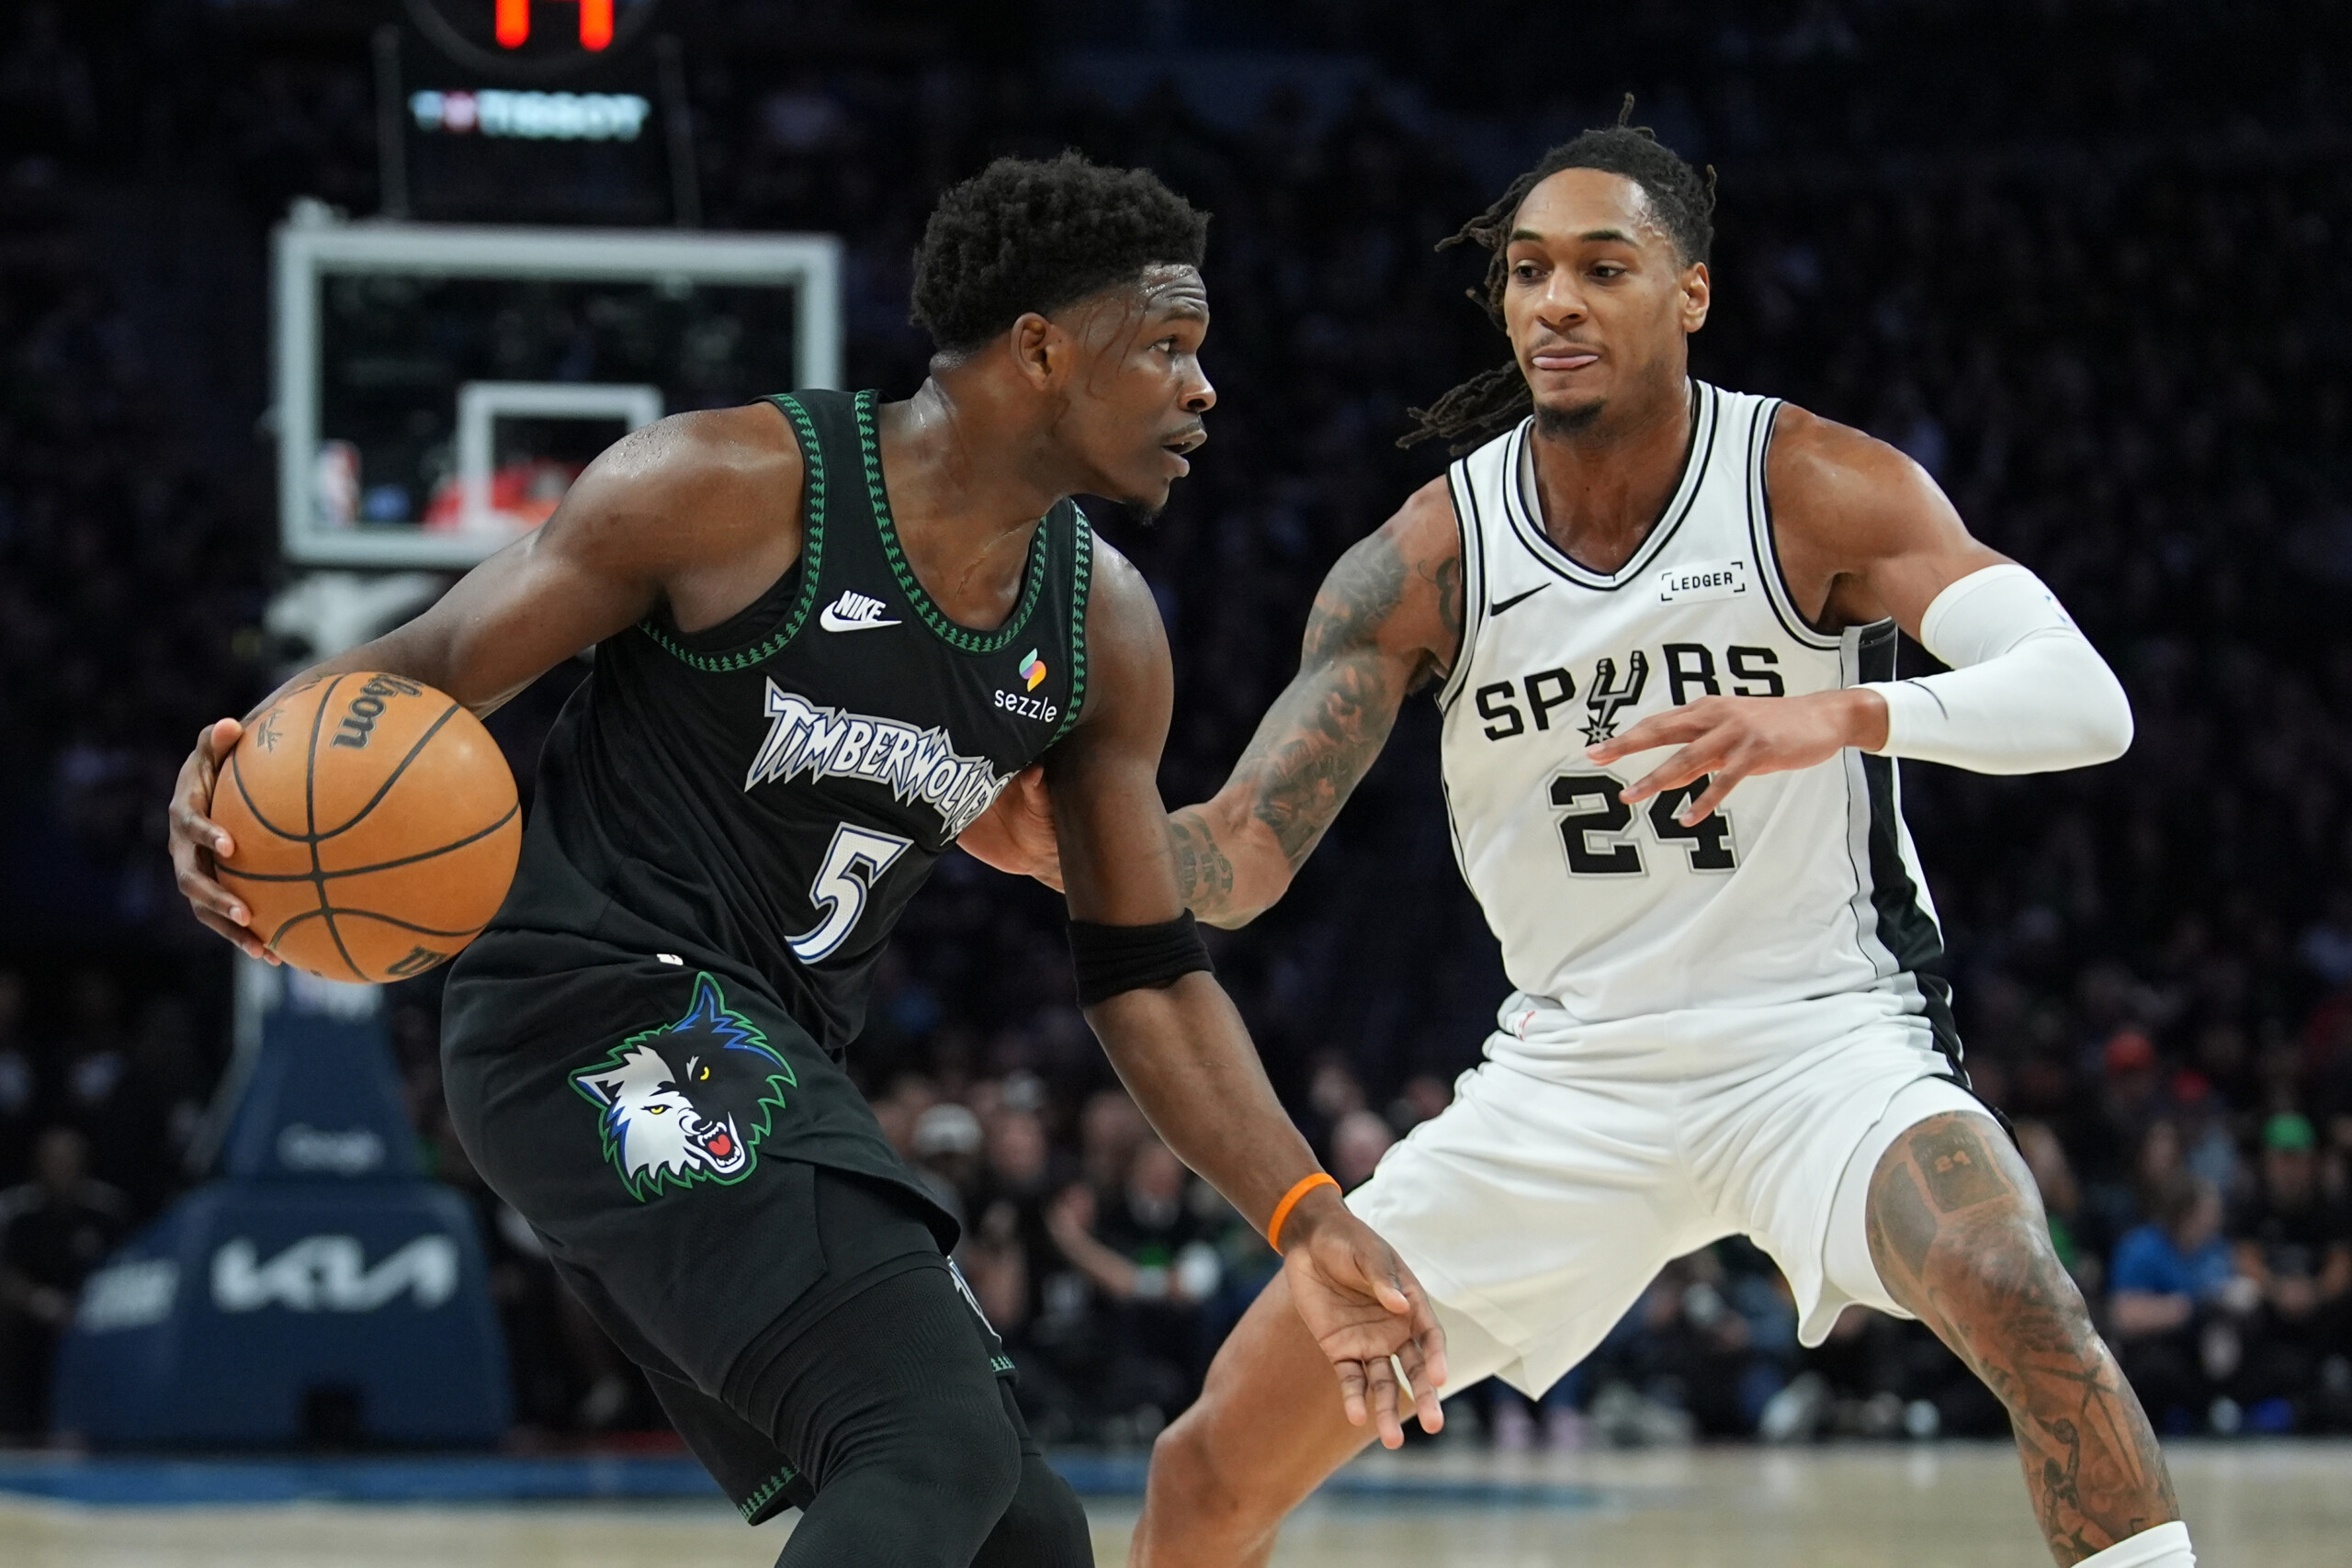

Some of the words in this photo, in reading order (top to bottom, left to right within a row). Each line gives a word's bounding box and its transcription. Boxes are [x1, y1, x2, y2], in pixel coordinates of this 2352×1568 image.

[834, 590, 887, 622] NIKE
[1670, 570, 1734, 592] LEDGER
[994, 689, 1057, 723] sezzle
[1475, 642, 1785, 747] SPURS
[1545, 768, 1739, 878] 24
[784, 821, 914, 964] 5
